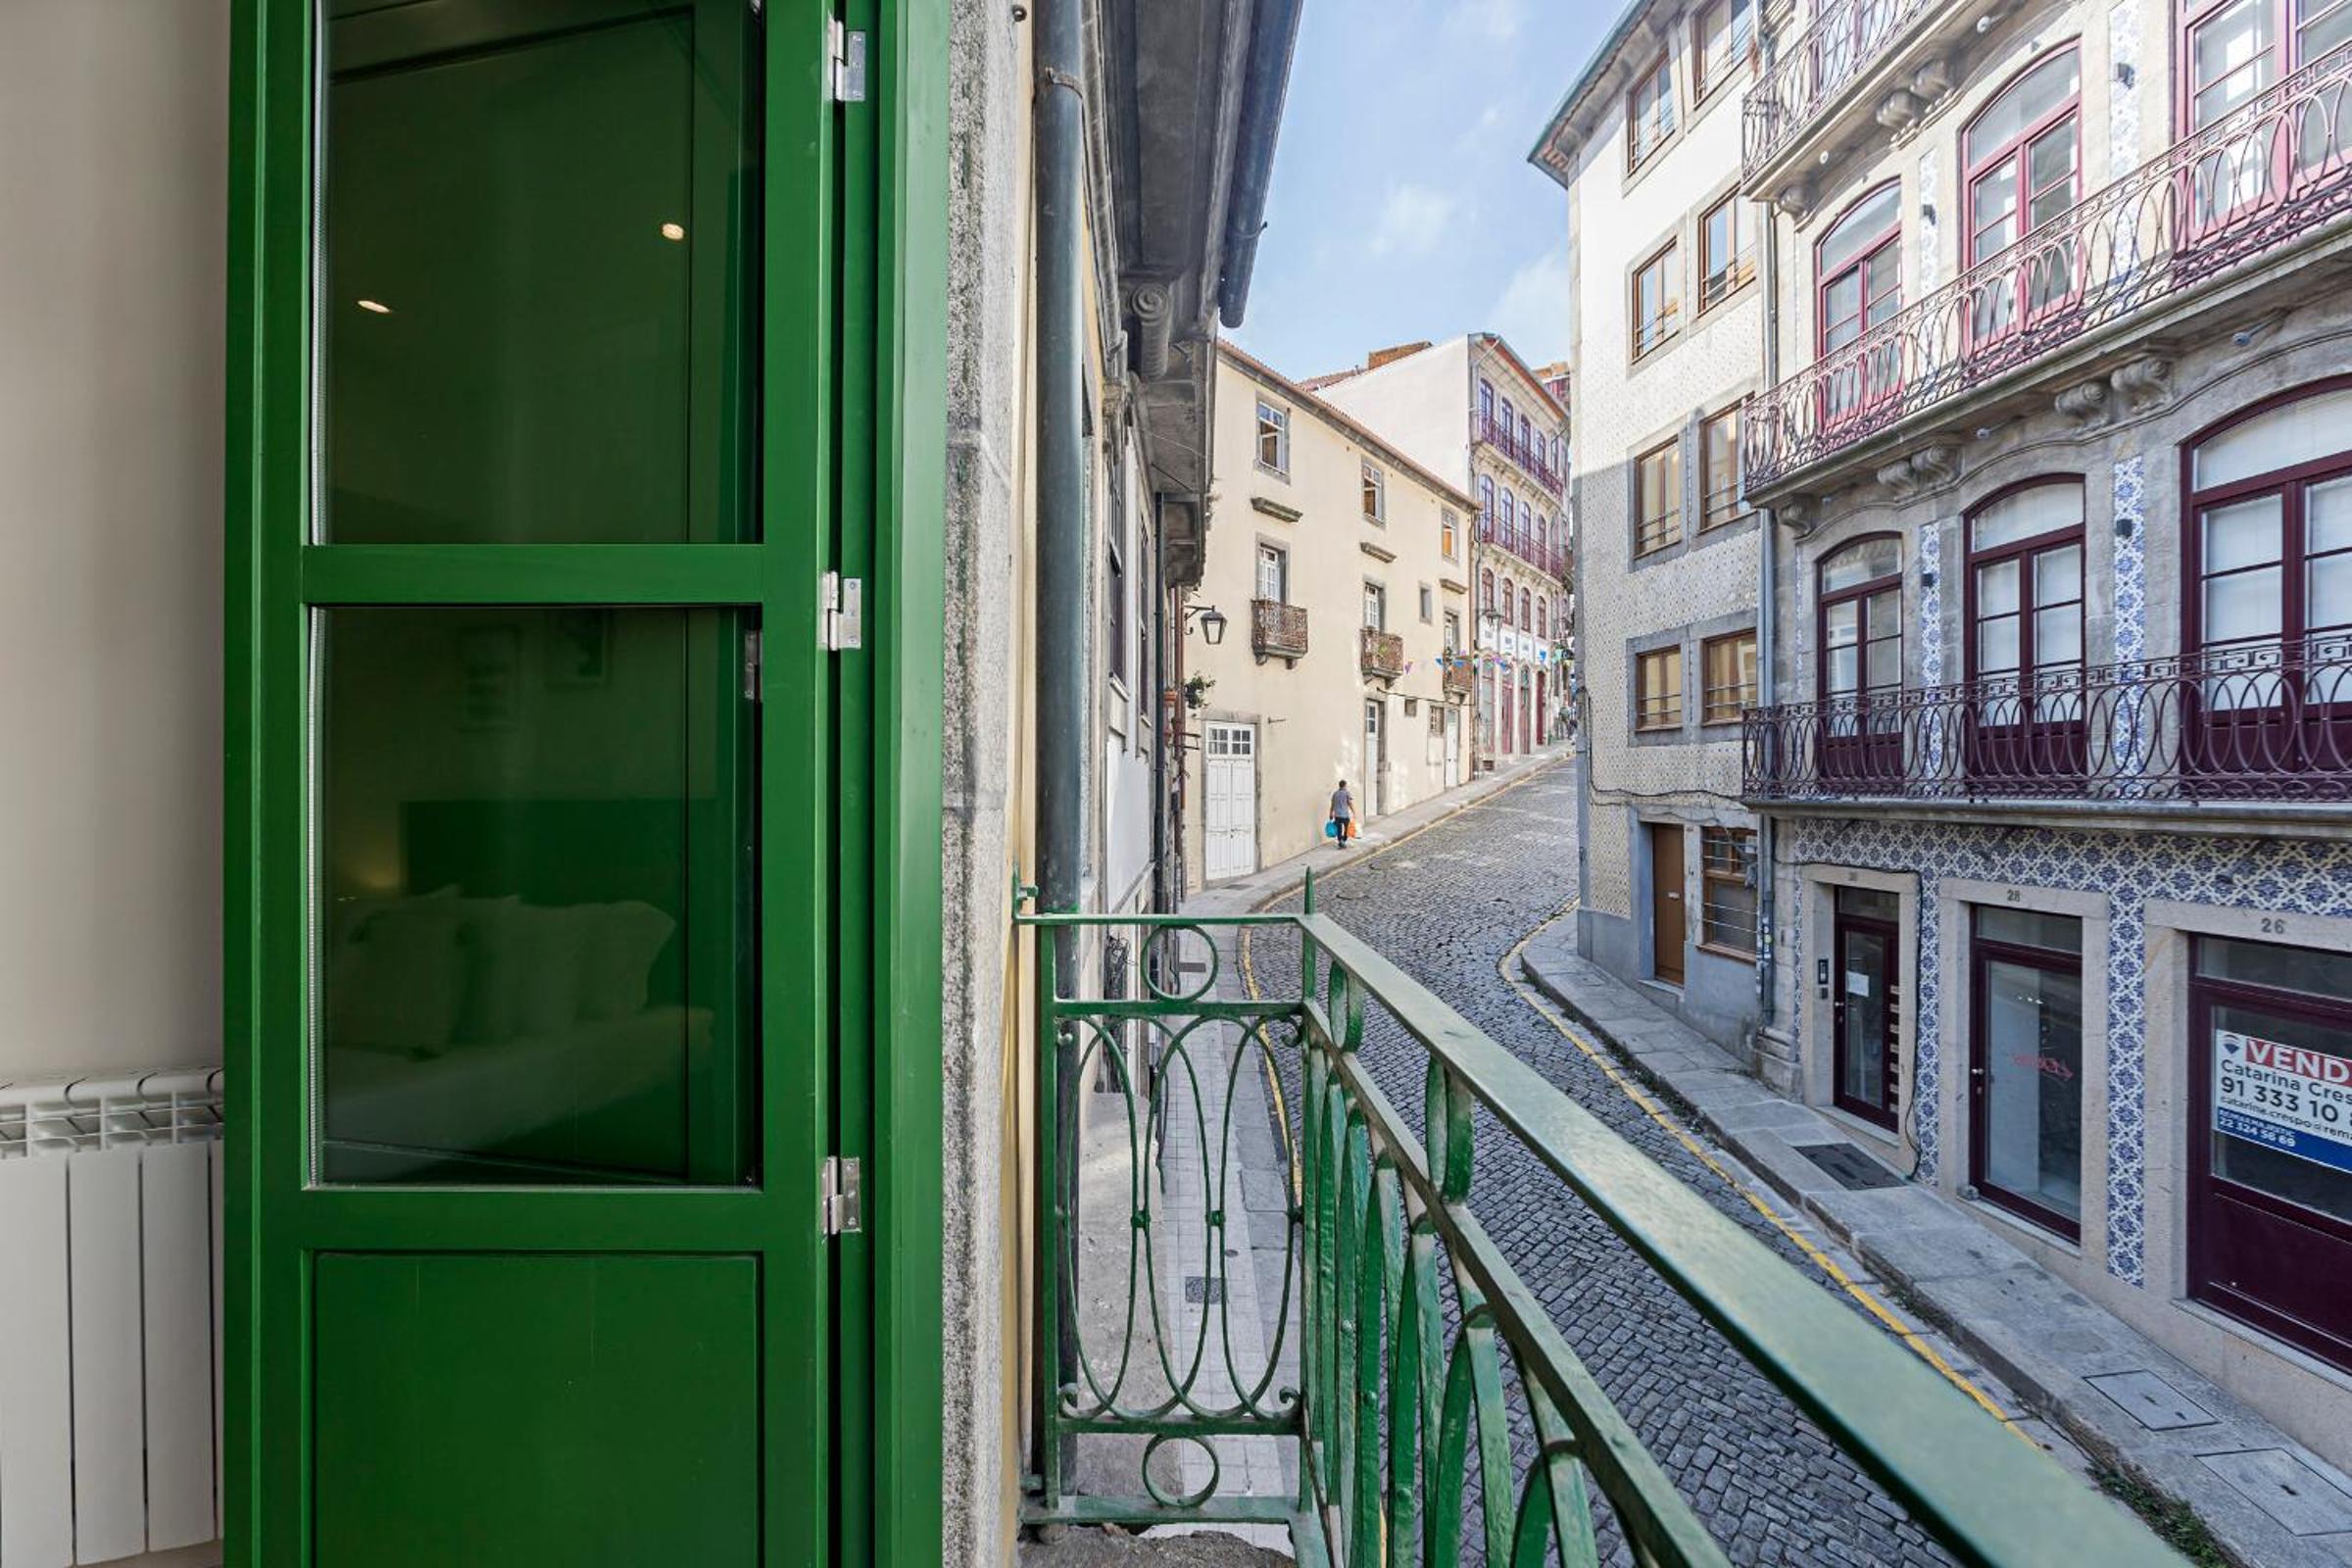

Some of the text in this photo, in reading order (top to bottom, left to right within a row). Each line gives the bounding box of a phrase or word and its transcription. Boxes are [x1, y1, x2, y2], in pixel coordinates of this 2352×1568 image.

[2006, 888, 2021, 903] 28
[2261, 917, 2285, 934] 26
[2221, 1058, 2301, 1092] Catarina
[2221, 1076, 2244, 1097] 91
[2254, 1085, 2299, 1112] 333
[2309, 1100, 2339, 1123] 10
